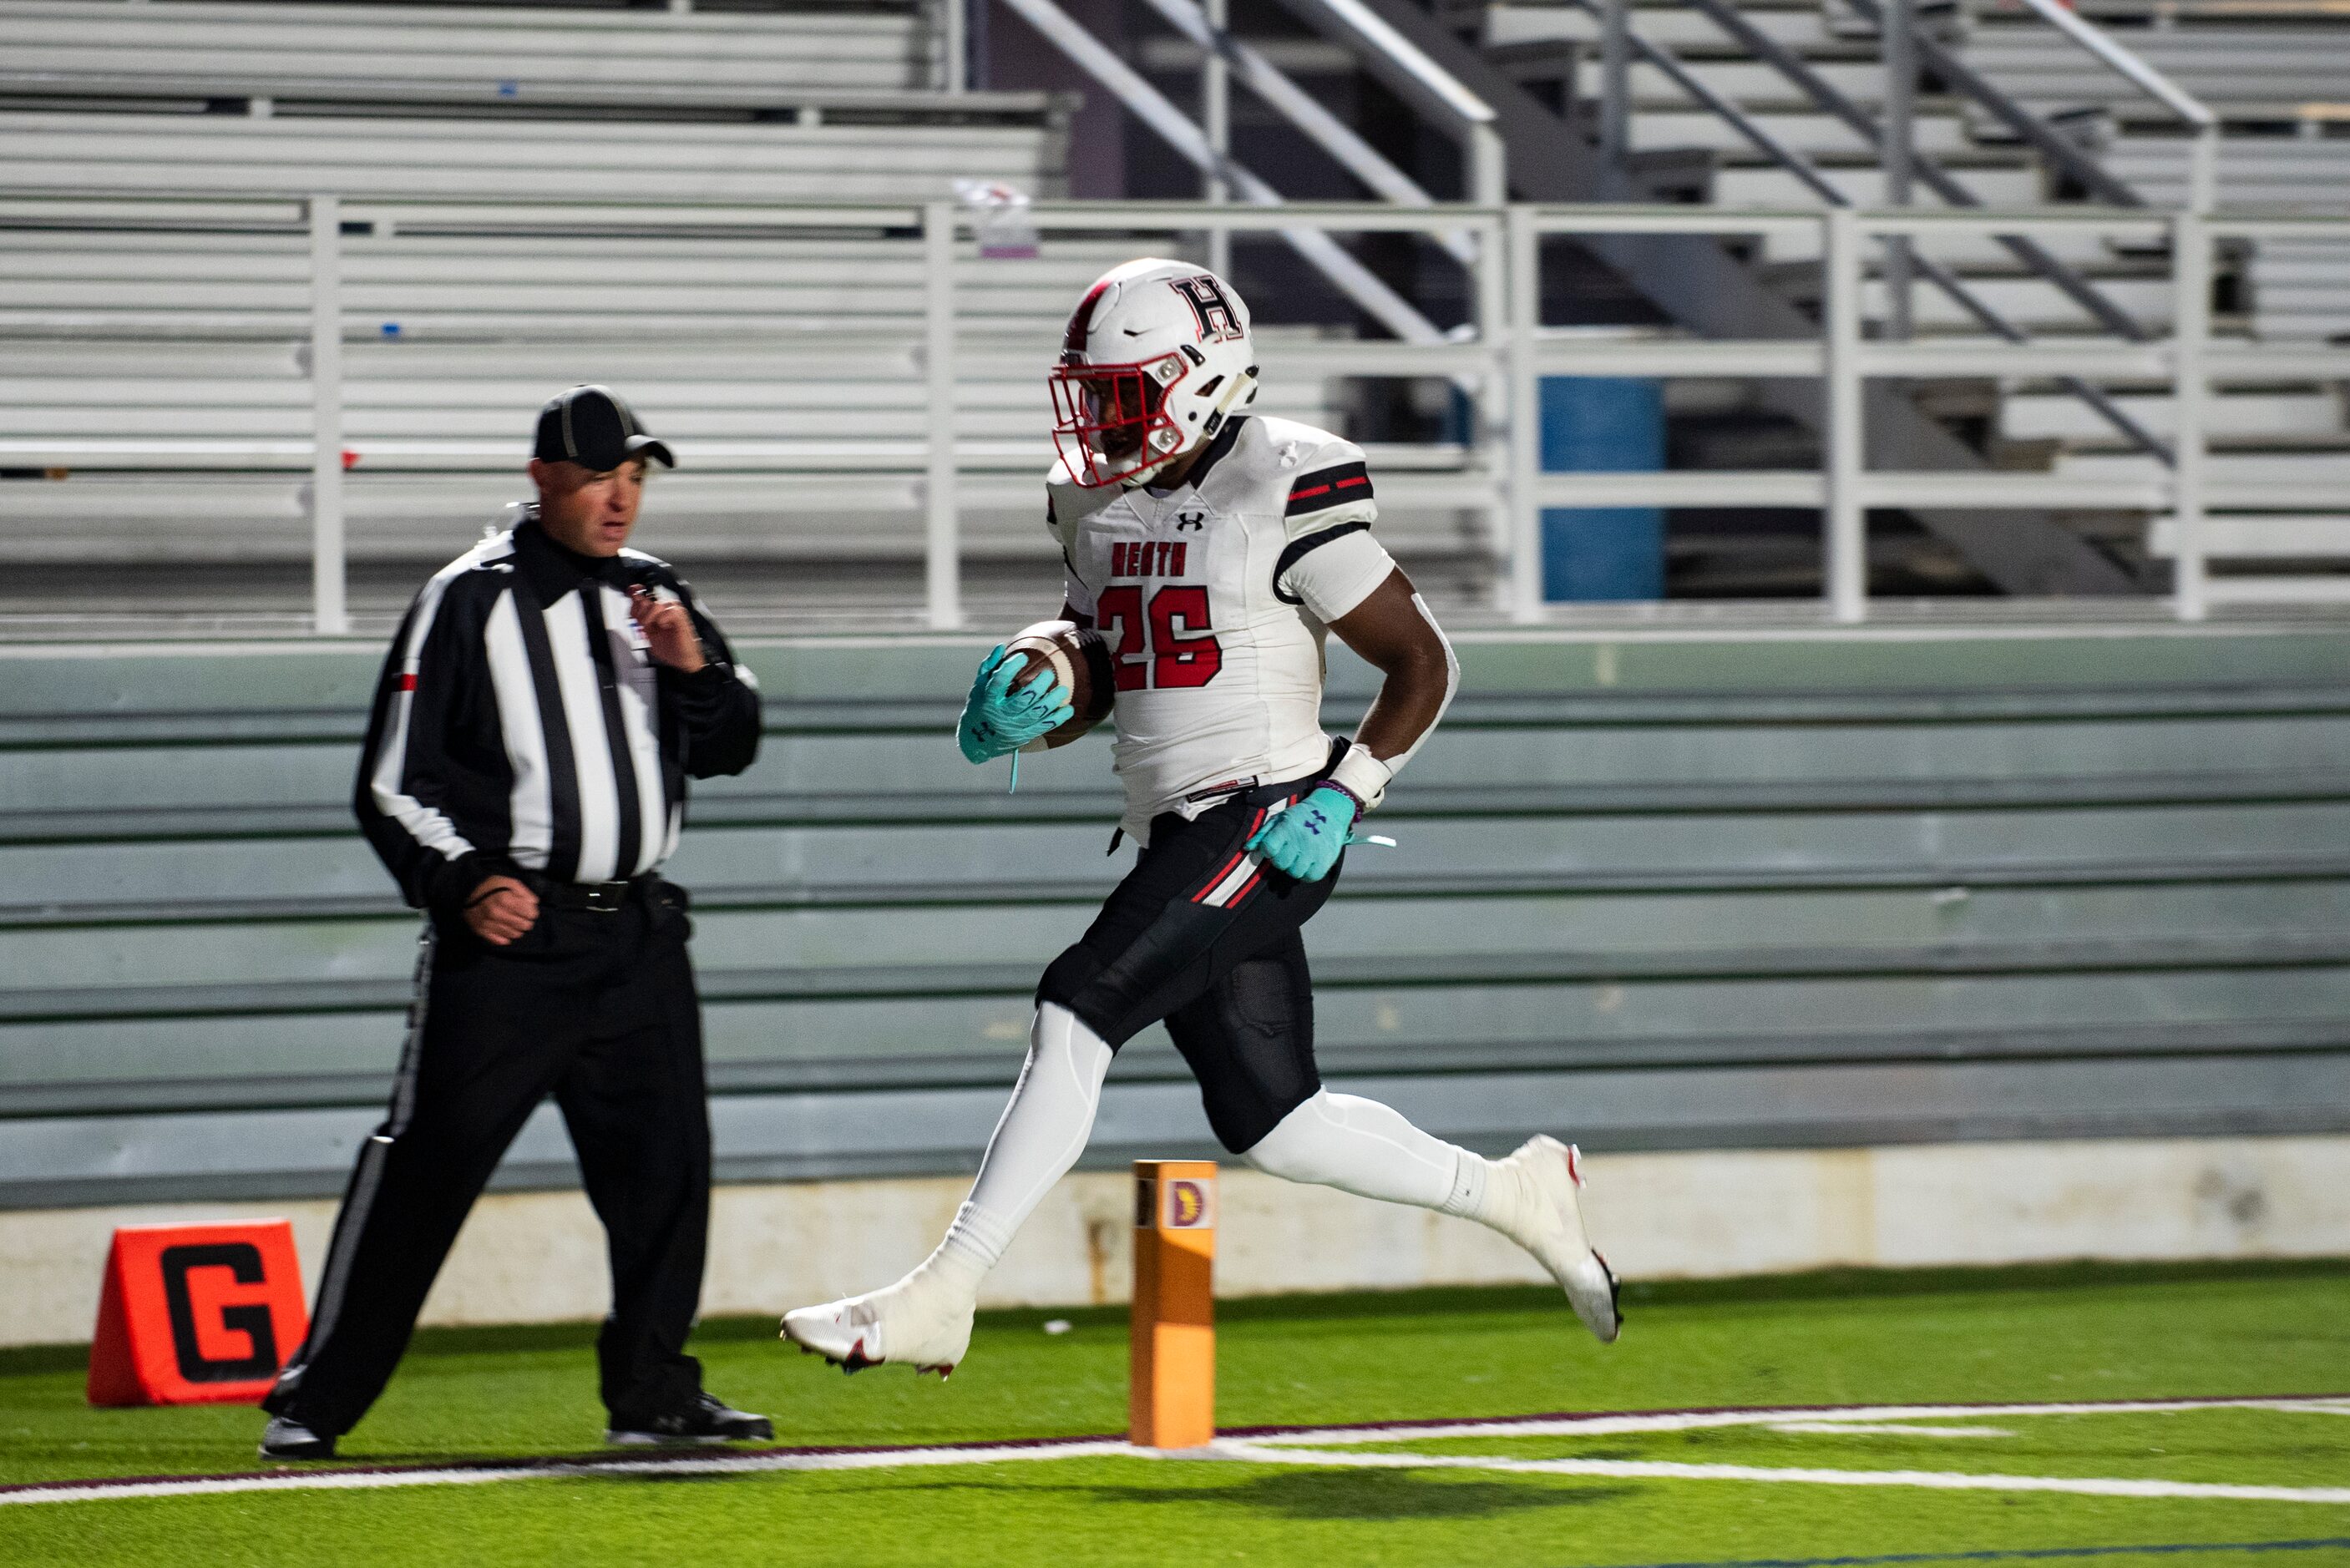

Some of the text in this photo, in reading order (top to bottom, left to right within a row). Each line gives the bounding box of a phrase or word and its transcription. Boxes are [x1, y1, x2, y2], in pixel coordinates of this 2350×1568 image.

[1168, 275, 1243, 343] H
[1112, 542, 1187, 576] HEATH
[1097, 585, 1223, 691] 26
[161, 1242, 278, 1383] G
